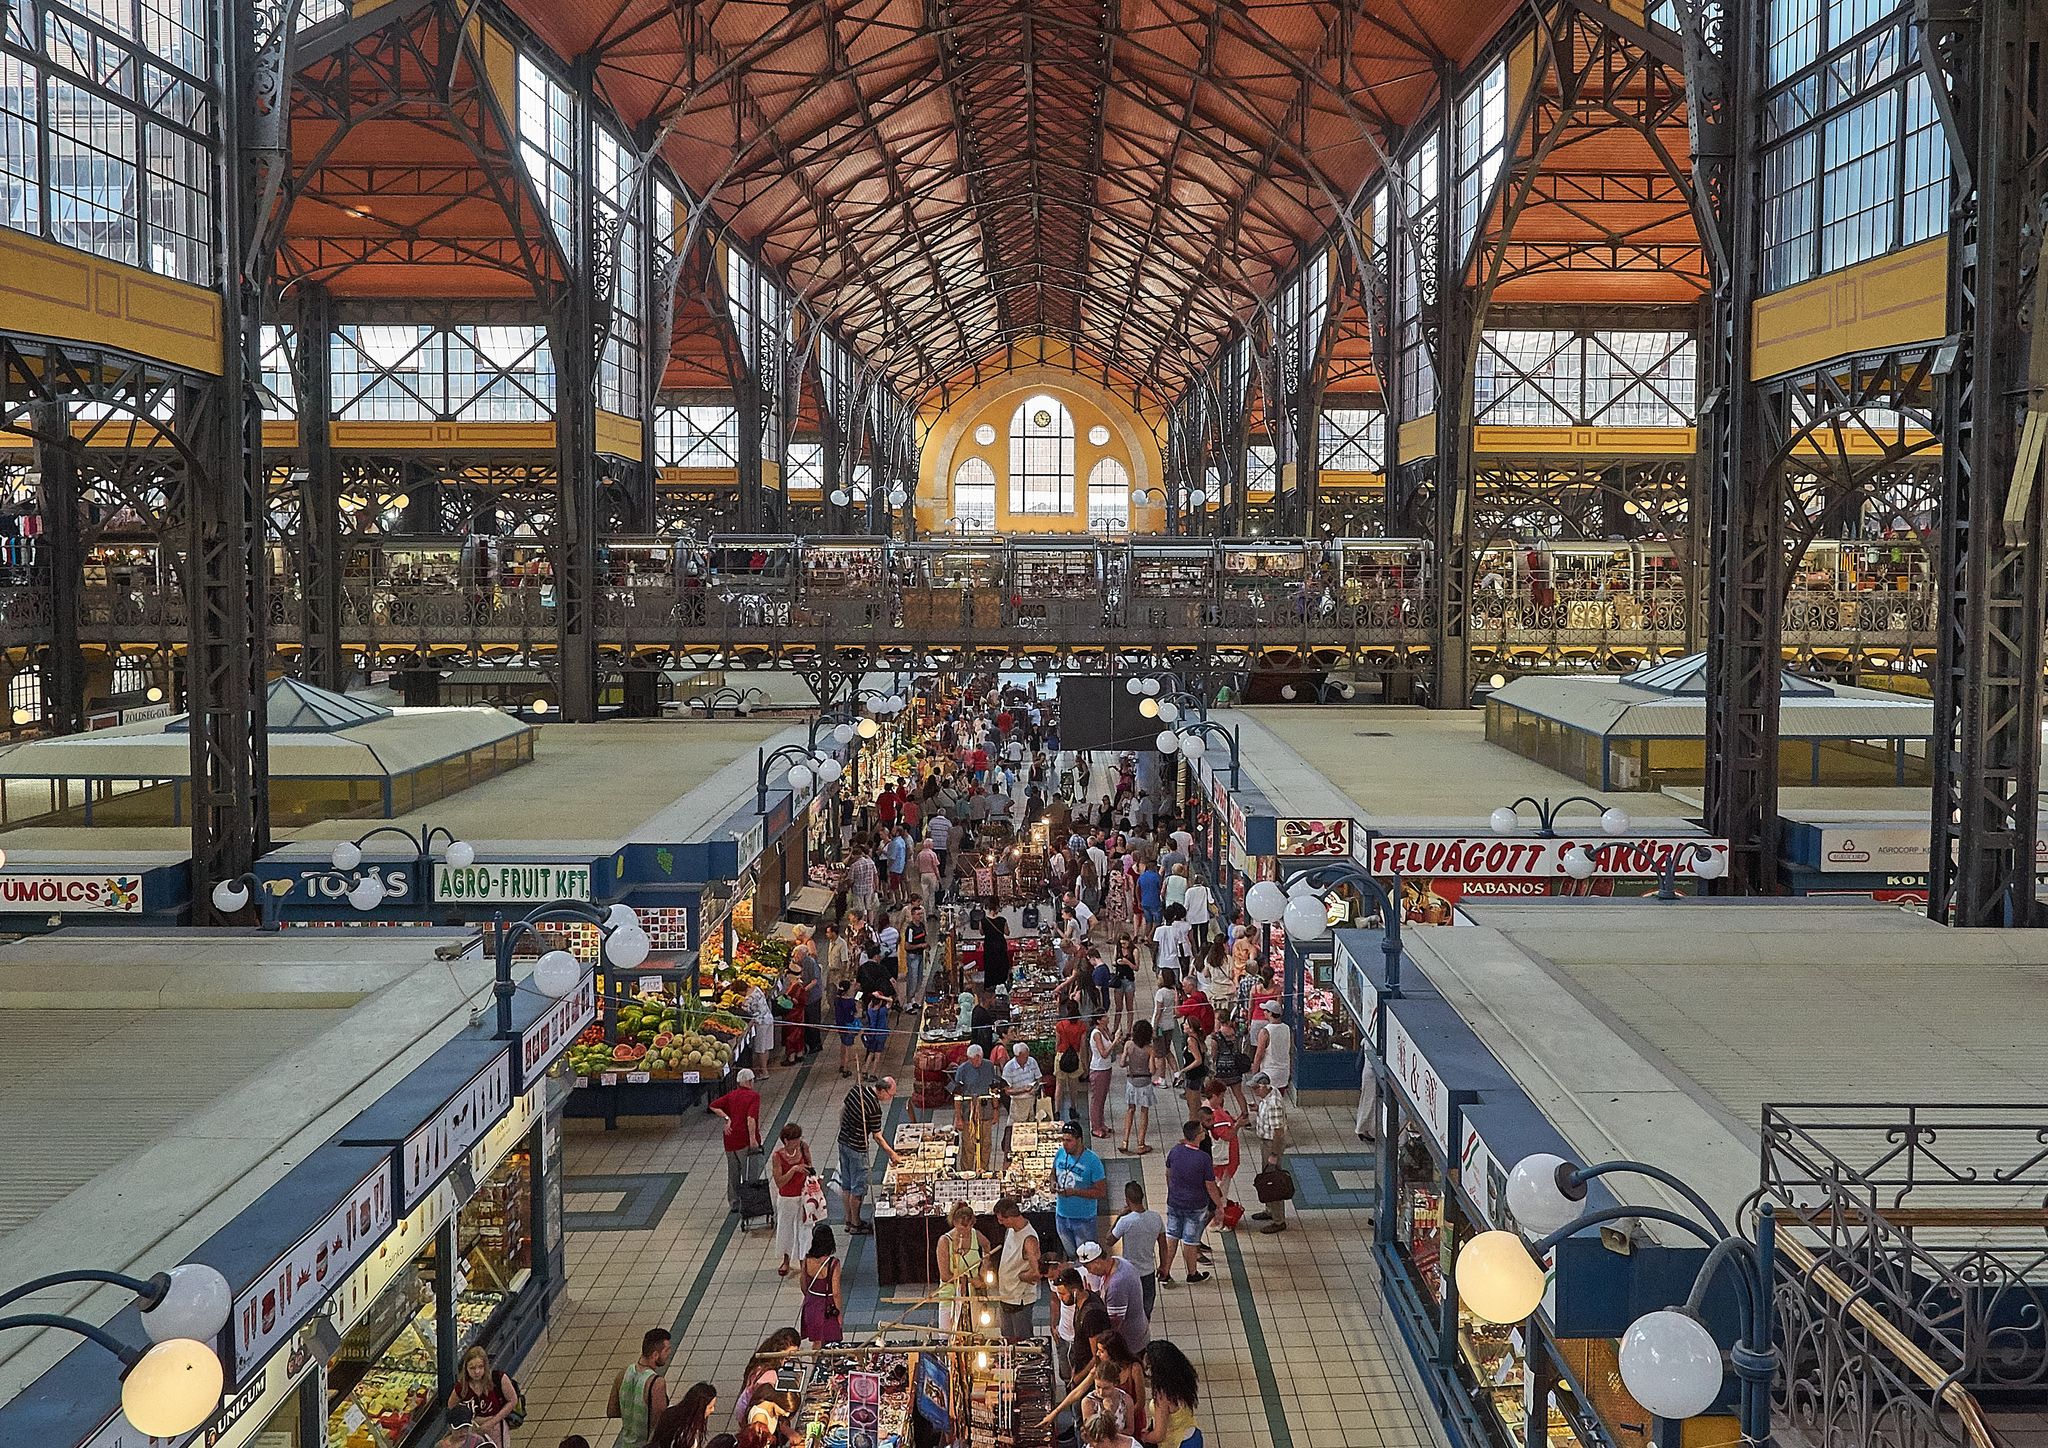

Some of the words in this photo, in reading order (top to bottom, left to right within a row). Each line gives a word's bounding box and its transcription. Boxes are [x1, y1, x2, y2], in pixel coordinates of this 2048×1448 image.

[1373, 839, 1546, 873] FELVÁGOTT
[0, 878, 100, 902] ÜMÖLCS
[300, 866, 409, 898] TOÁS
[439, 867, 551, 898] AGRO-FRUIT
[1463, 882, 1545, 895] KABANOS
[217, 1375, 265, 1434] UNICUM
